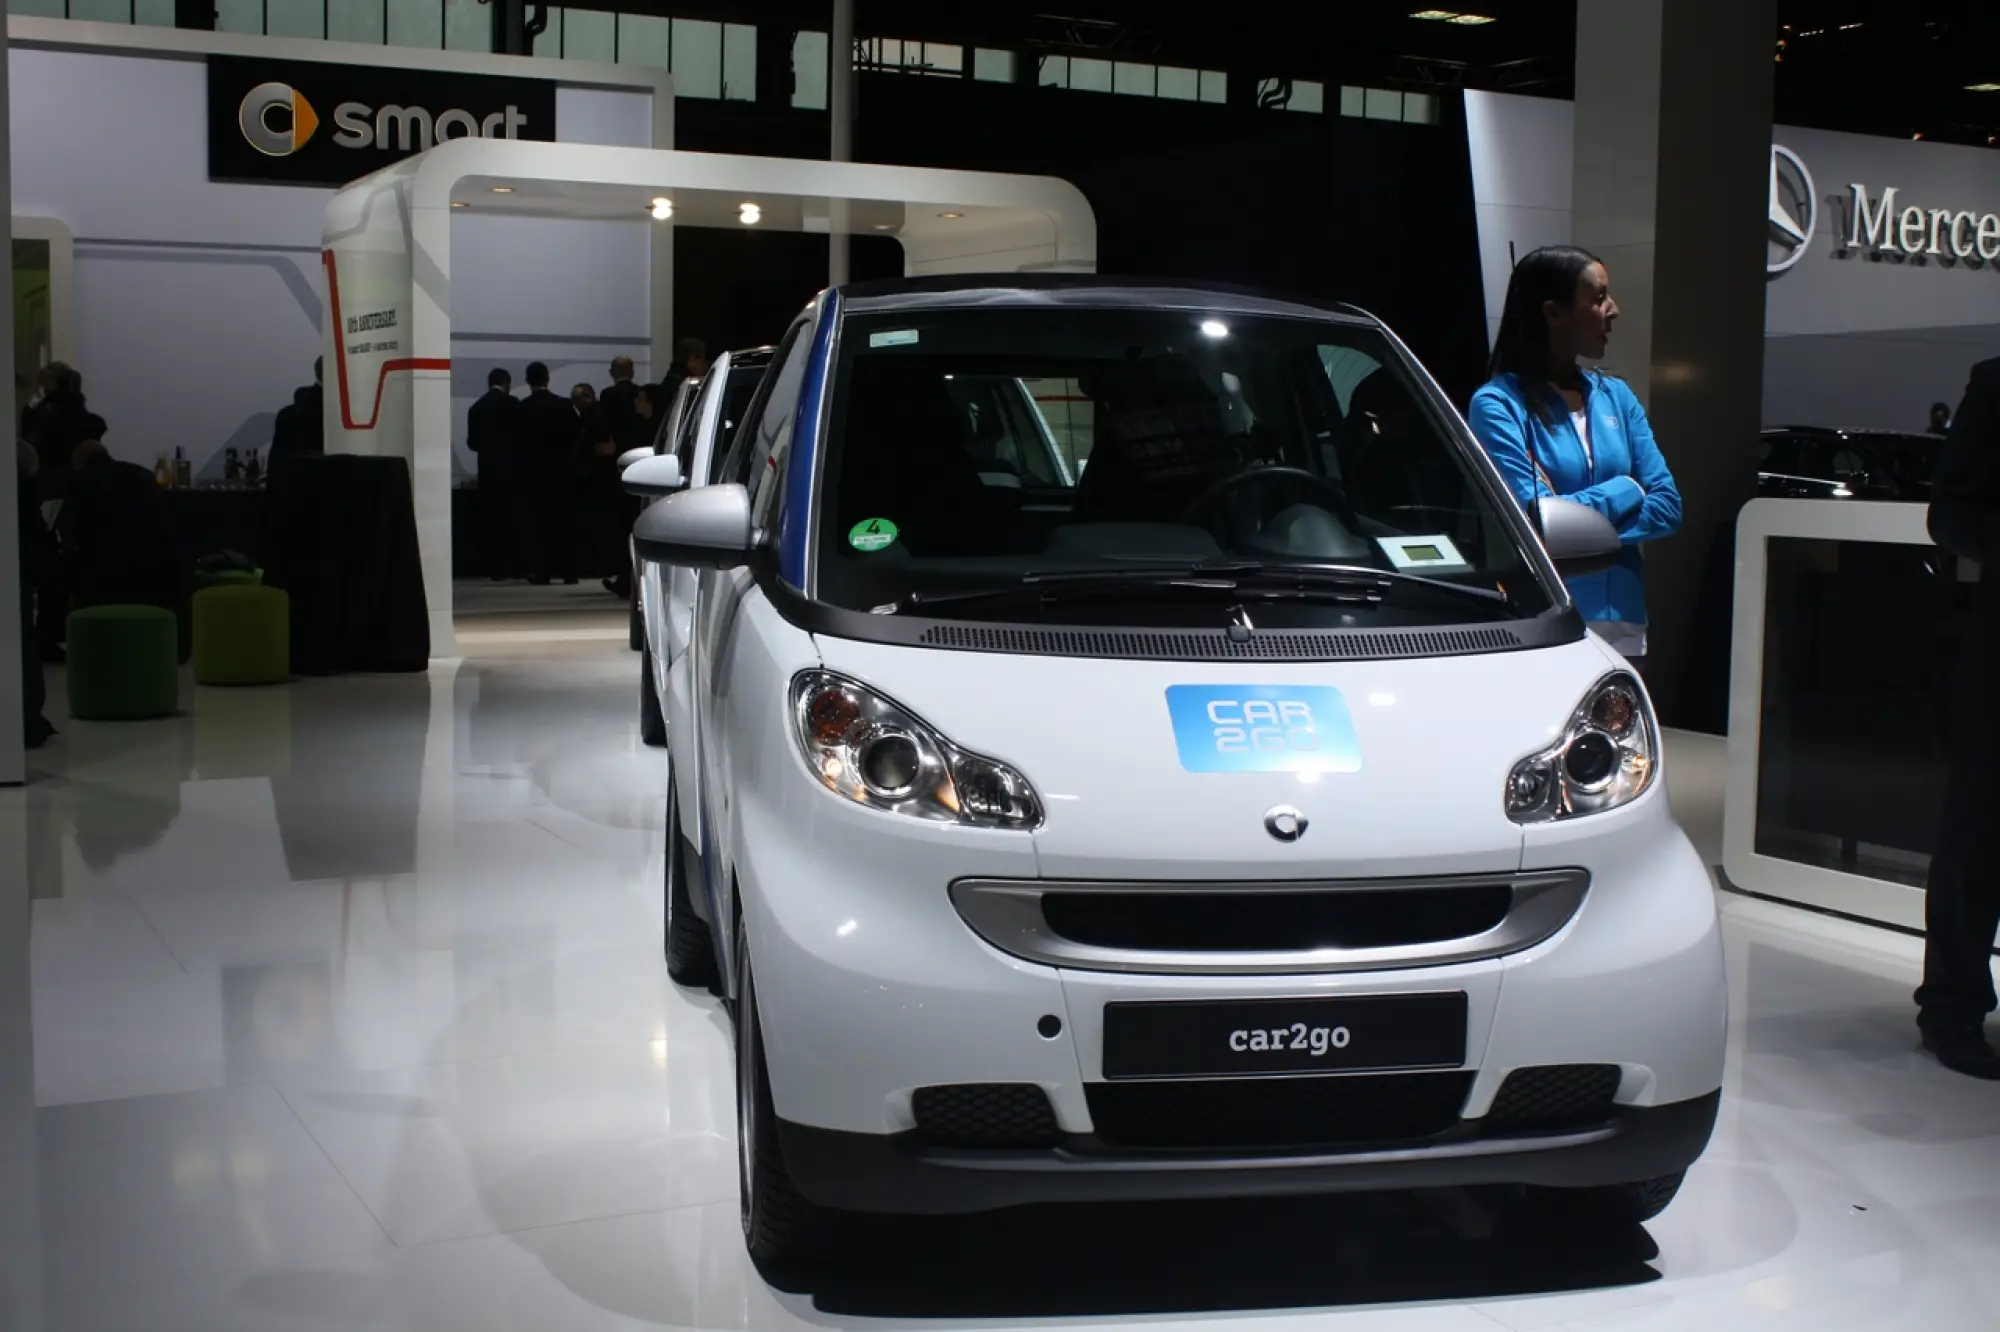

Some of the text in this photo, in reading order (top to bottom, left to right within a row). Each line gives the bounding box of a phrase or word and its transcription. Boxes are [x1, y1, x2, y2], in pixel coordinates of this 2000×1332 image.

[333, 102, 527, 150] smart
[865, 519, 880, 534] 4
[1207, 700, 1315, 728] CAR
[1213, 727, 1320, 752] 2GO
[1229, 1022, 1351, 1056] car2go
